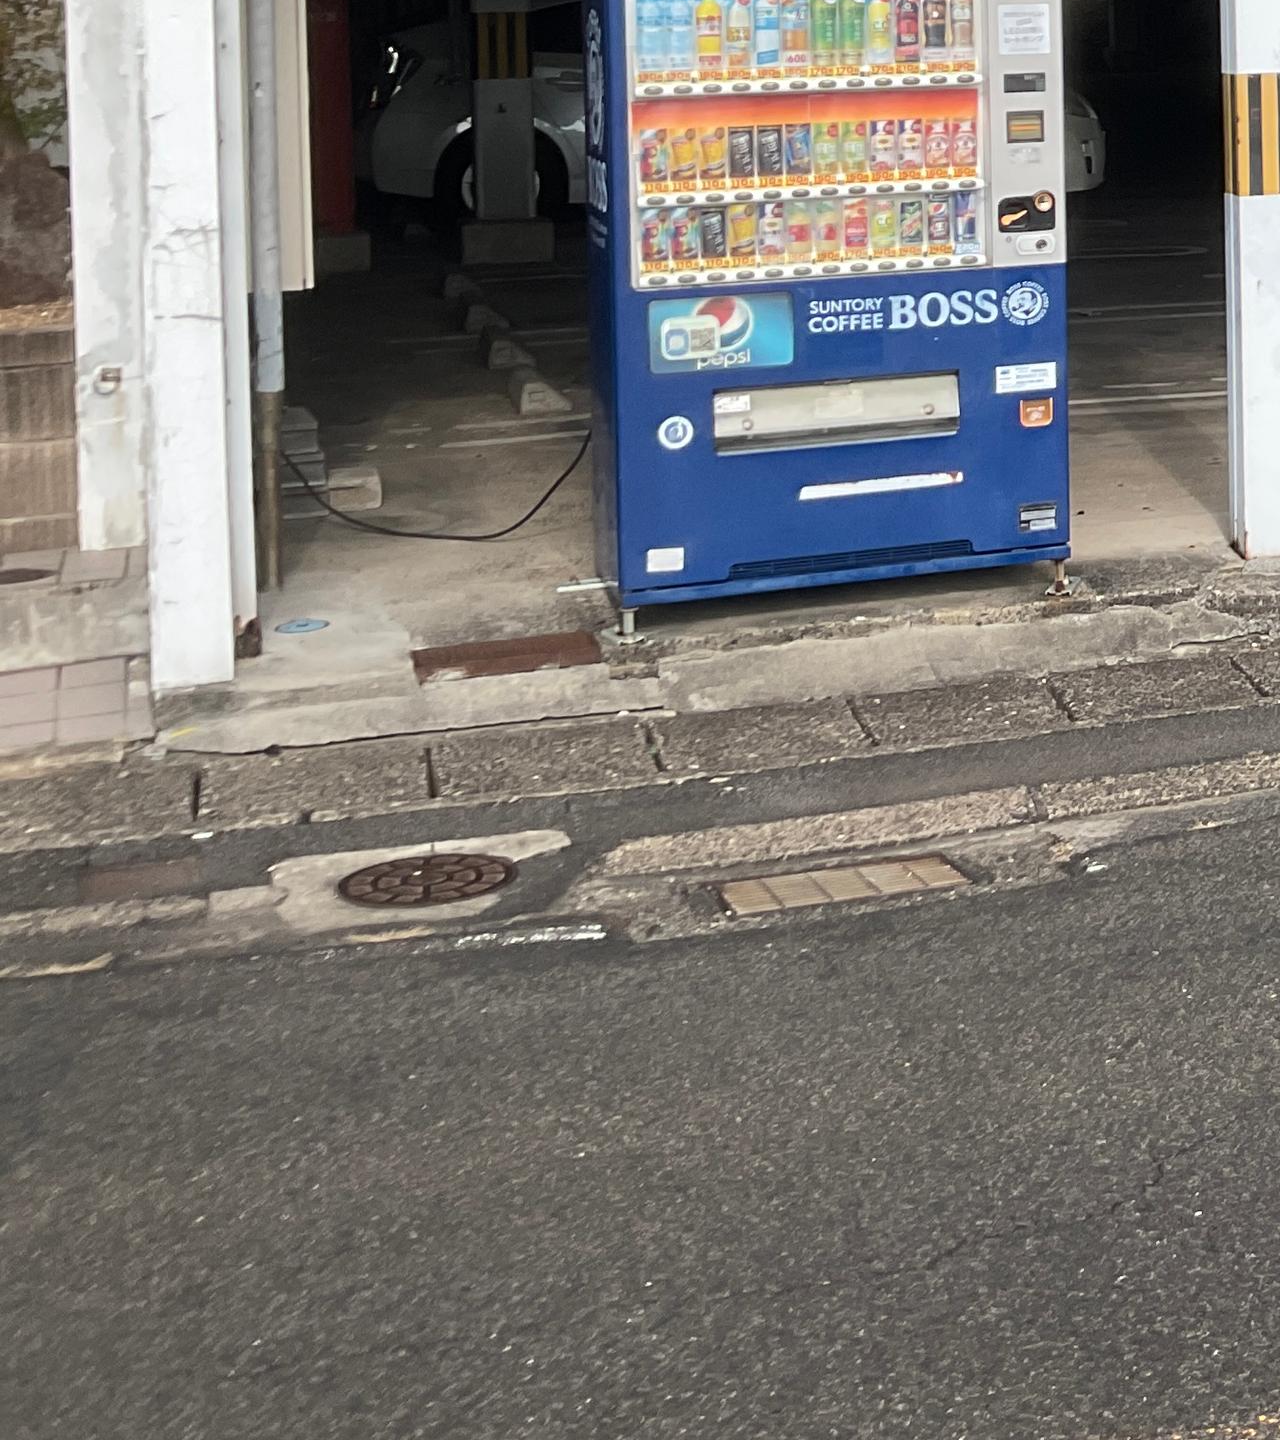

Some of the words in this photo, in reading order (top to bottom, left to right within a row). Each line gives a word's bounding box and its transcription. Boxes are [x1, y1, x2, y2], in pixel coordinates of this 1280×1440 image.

[808, 296, 884, 315] SUNTORY
[886, 288, 999, 331] BOSS
[808, 312, 884, 334] COFFEE
[696, 347, 751, 371] pepsi
